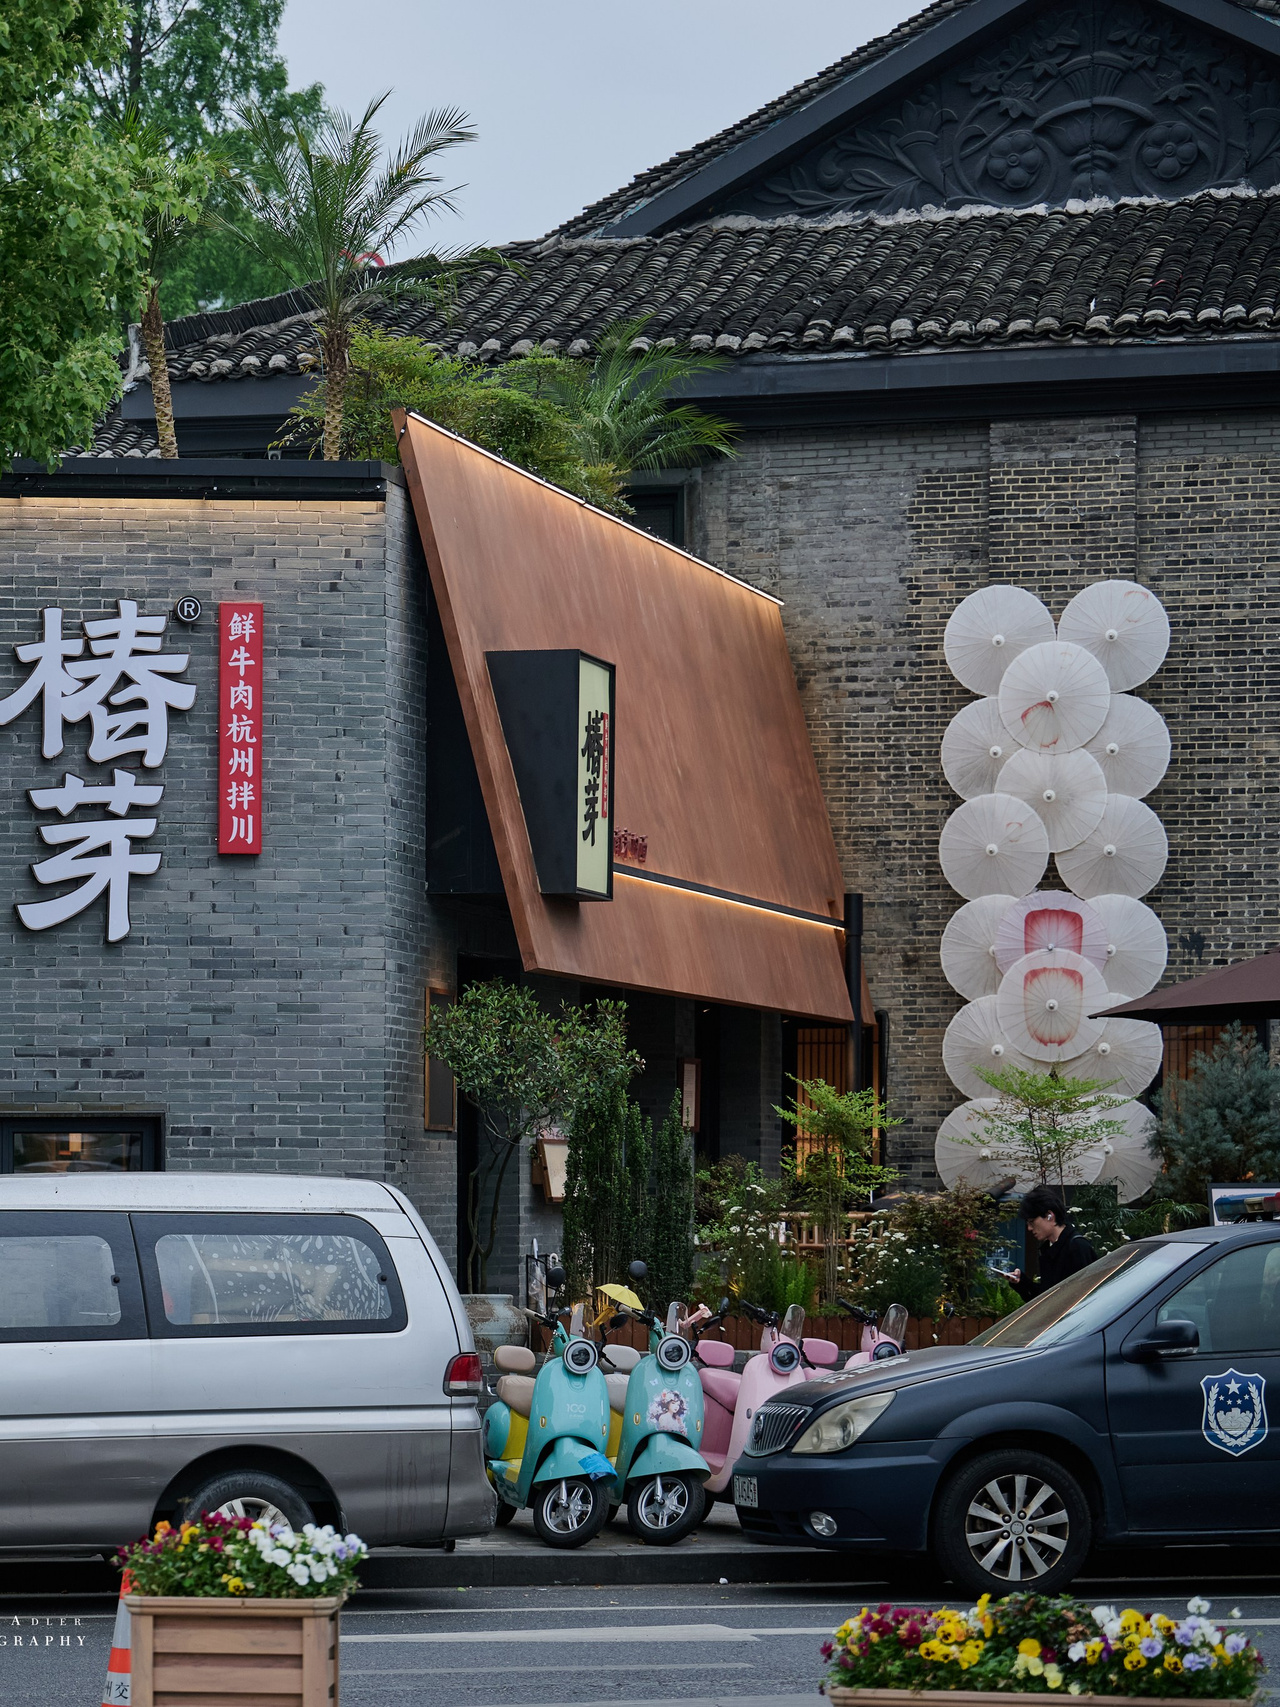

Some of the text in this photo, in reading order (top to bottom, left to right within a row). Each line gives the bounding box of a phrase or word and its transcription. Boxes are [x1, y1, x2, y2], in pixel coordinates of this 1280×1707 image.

[226, 611, 257, 844] 鲜牛肉杭州拌川
